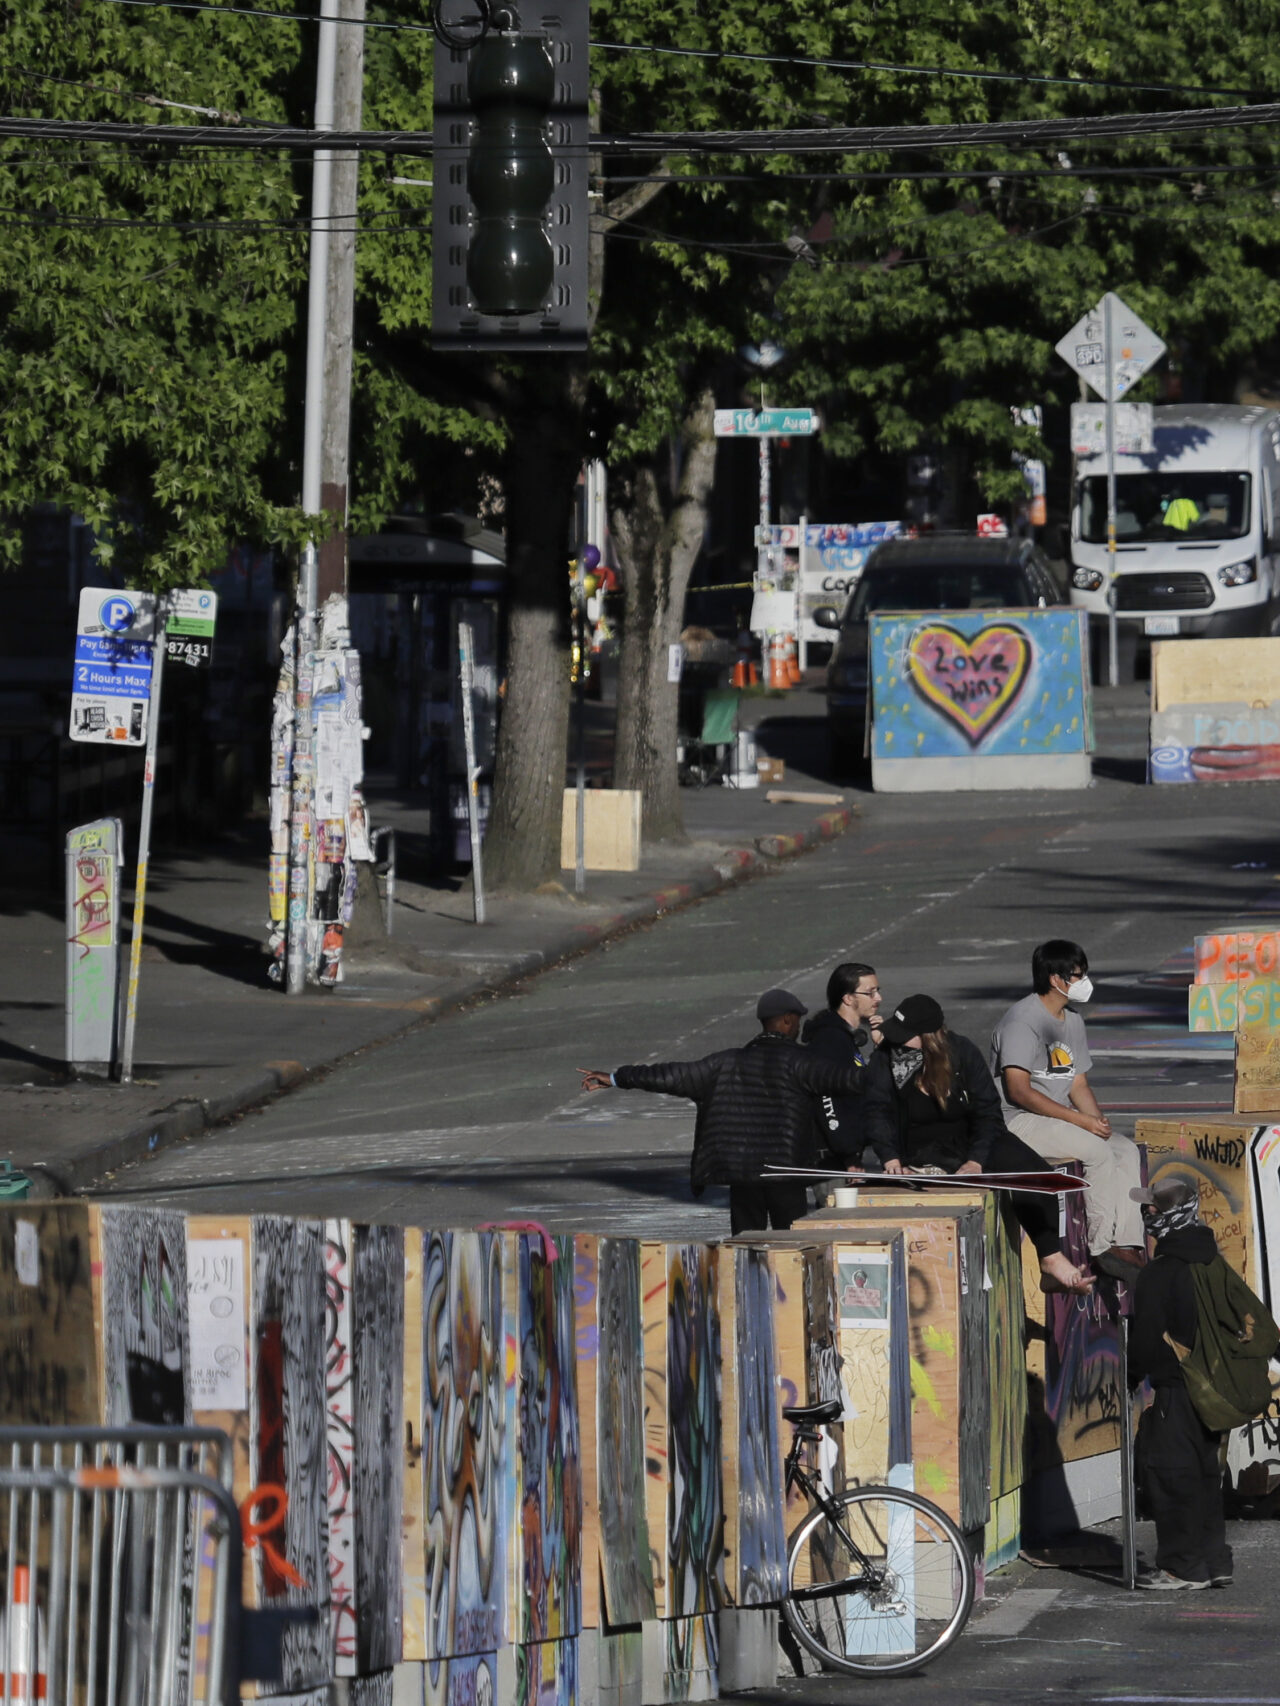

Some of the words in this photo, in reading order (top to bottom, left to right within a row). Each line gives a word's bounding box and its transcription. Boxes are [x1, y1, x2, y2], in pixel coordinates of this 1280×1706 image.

[80, 638, 98, 650] Pay
[168, 641, 208, 657] 87431
[935, 645, 1009, 674] Love
[78, 667, 88, 681] 2
[90, 671, 122, 684] Hours
[124, 675, 146, 687] Max
[1193, 718, 1280, 746] FOOD
[1194, 1134, 1246, 1168] WWJD?
